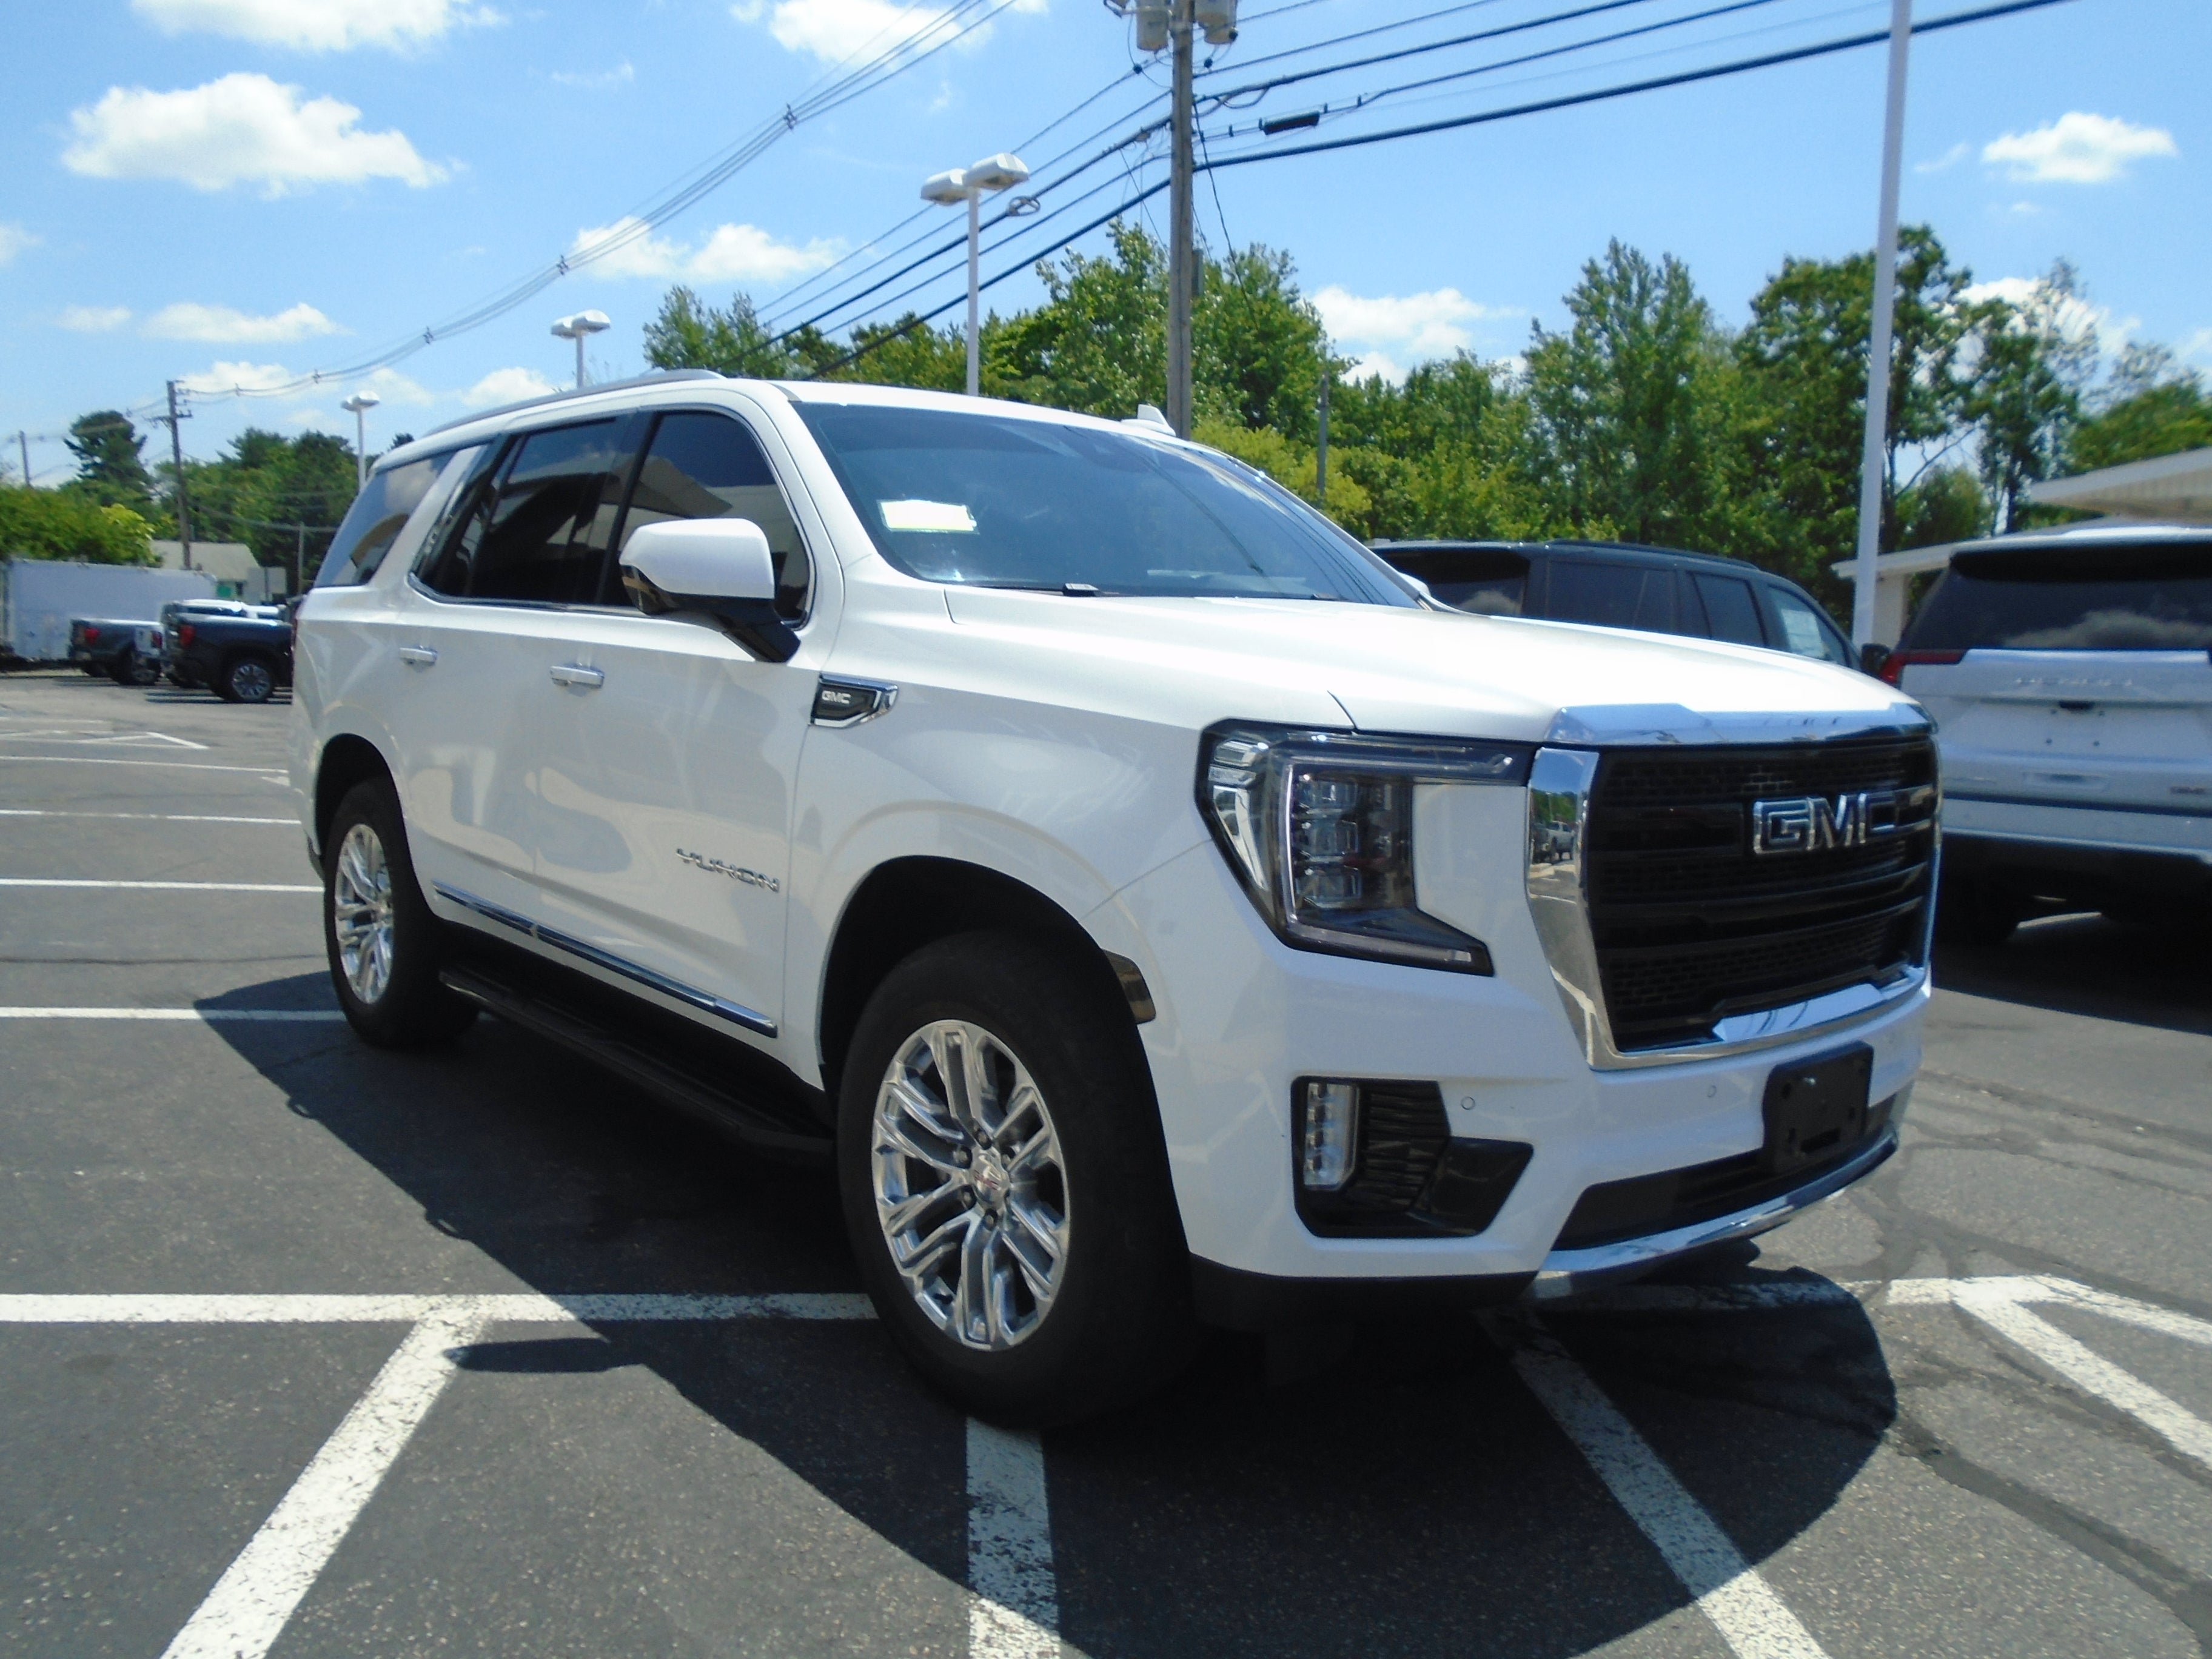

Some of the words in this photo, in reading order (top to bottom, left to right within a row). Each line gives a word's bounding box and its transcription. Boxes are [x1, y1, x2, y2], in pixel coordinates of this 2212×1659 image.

[822, 690, 851, 704] GMC
[1753, 793, 1897, 854] GMC
[676, 848, 780, 893] YUKON
